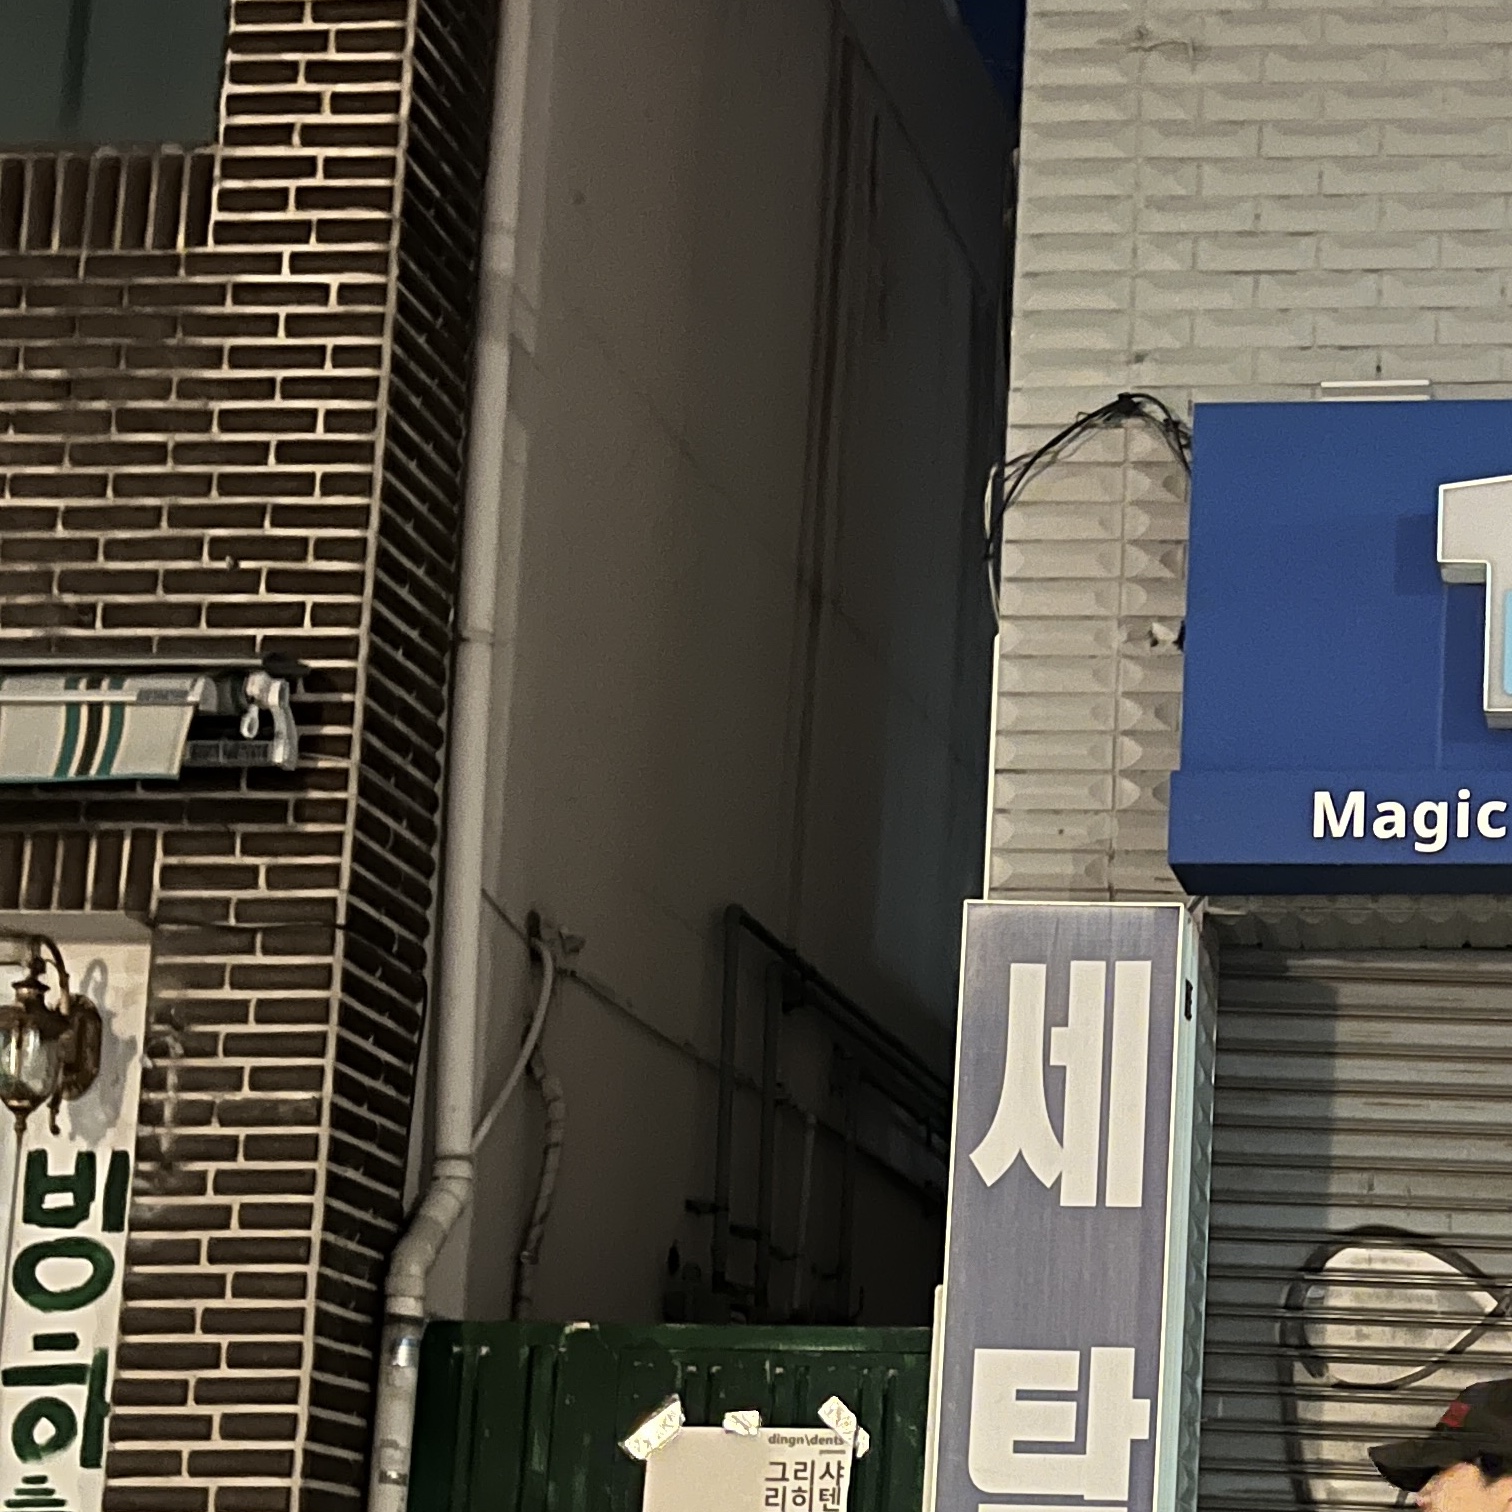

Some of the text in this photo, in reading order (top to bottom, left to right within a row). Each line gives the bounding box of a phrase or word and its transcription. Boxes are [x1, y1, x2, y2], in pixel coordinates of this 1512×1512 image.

[1312, 788, 1508, 852] Magic
[764, 1460, 845, 1487] 그리샤
[764, 1486, 841, 1512] 리히텐
